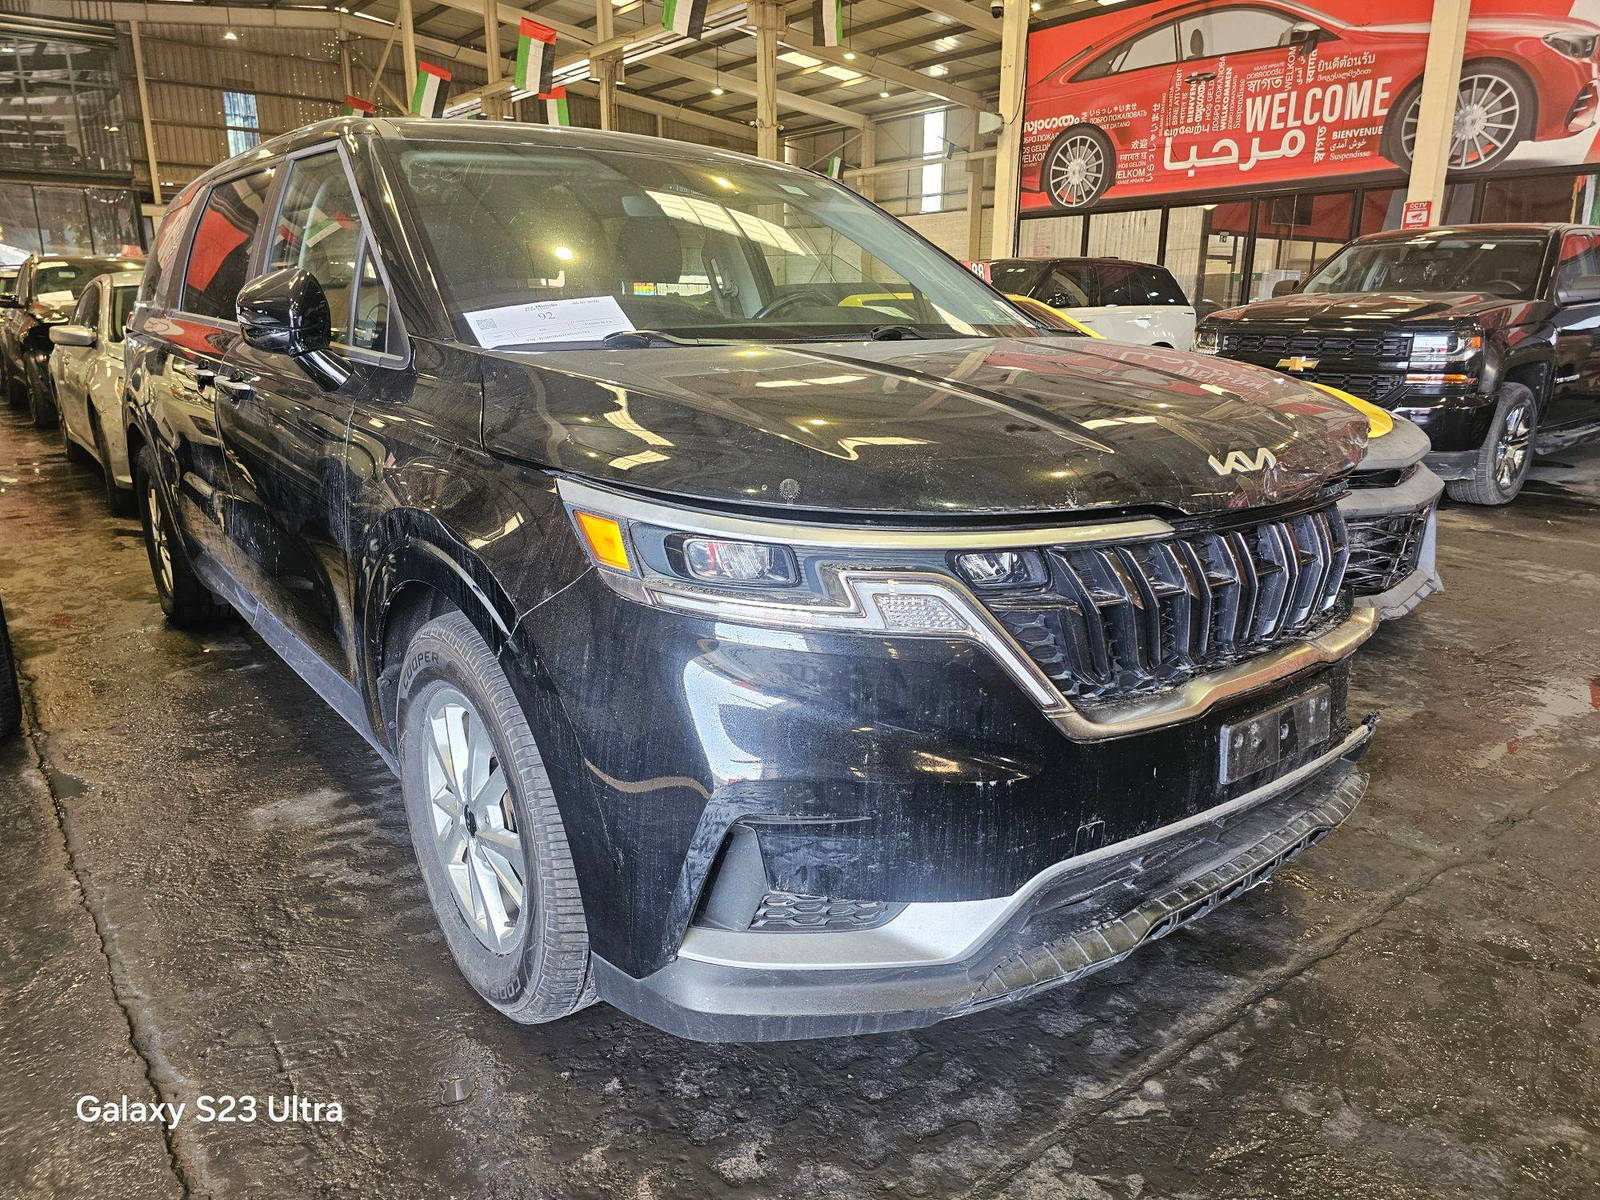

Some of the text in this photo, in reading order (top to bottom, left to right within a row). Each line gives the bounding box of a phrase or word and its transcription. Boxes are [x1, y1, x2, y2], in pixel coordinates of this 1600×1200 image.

[1285, 46, 1296, 91] WELKOM
[1220, 67, 1232, 131] WILLKOMMEN
[1233, 79, 1245, 129] Suspendisse
[1245, 76, 1393, 134] WELCOME
[1162, 128, 1306, 178] مرحبا
[1332, 125, 1384, 141] BIENVENUE
[537, 311, 556, 320] 92
[1207, 447, 1277, 476] KIA
[403, 650, 439, 690] COOPER
